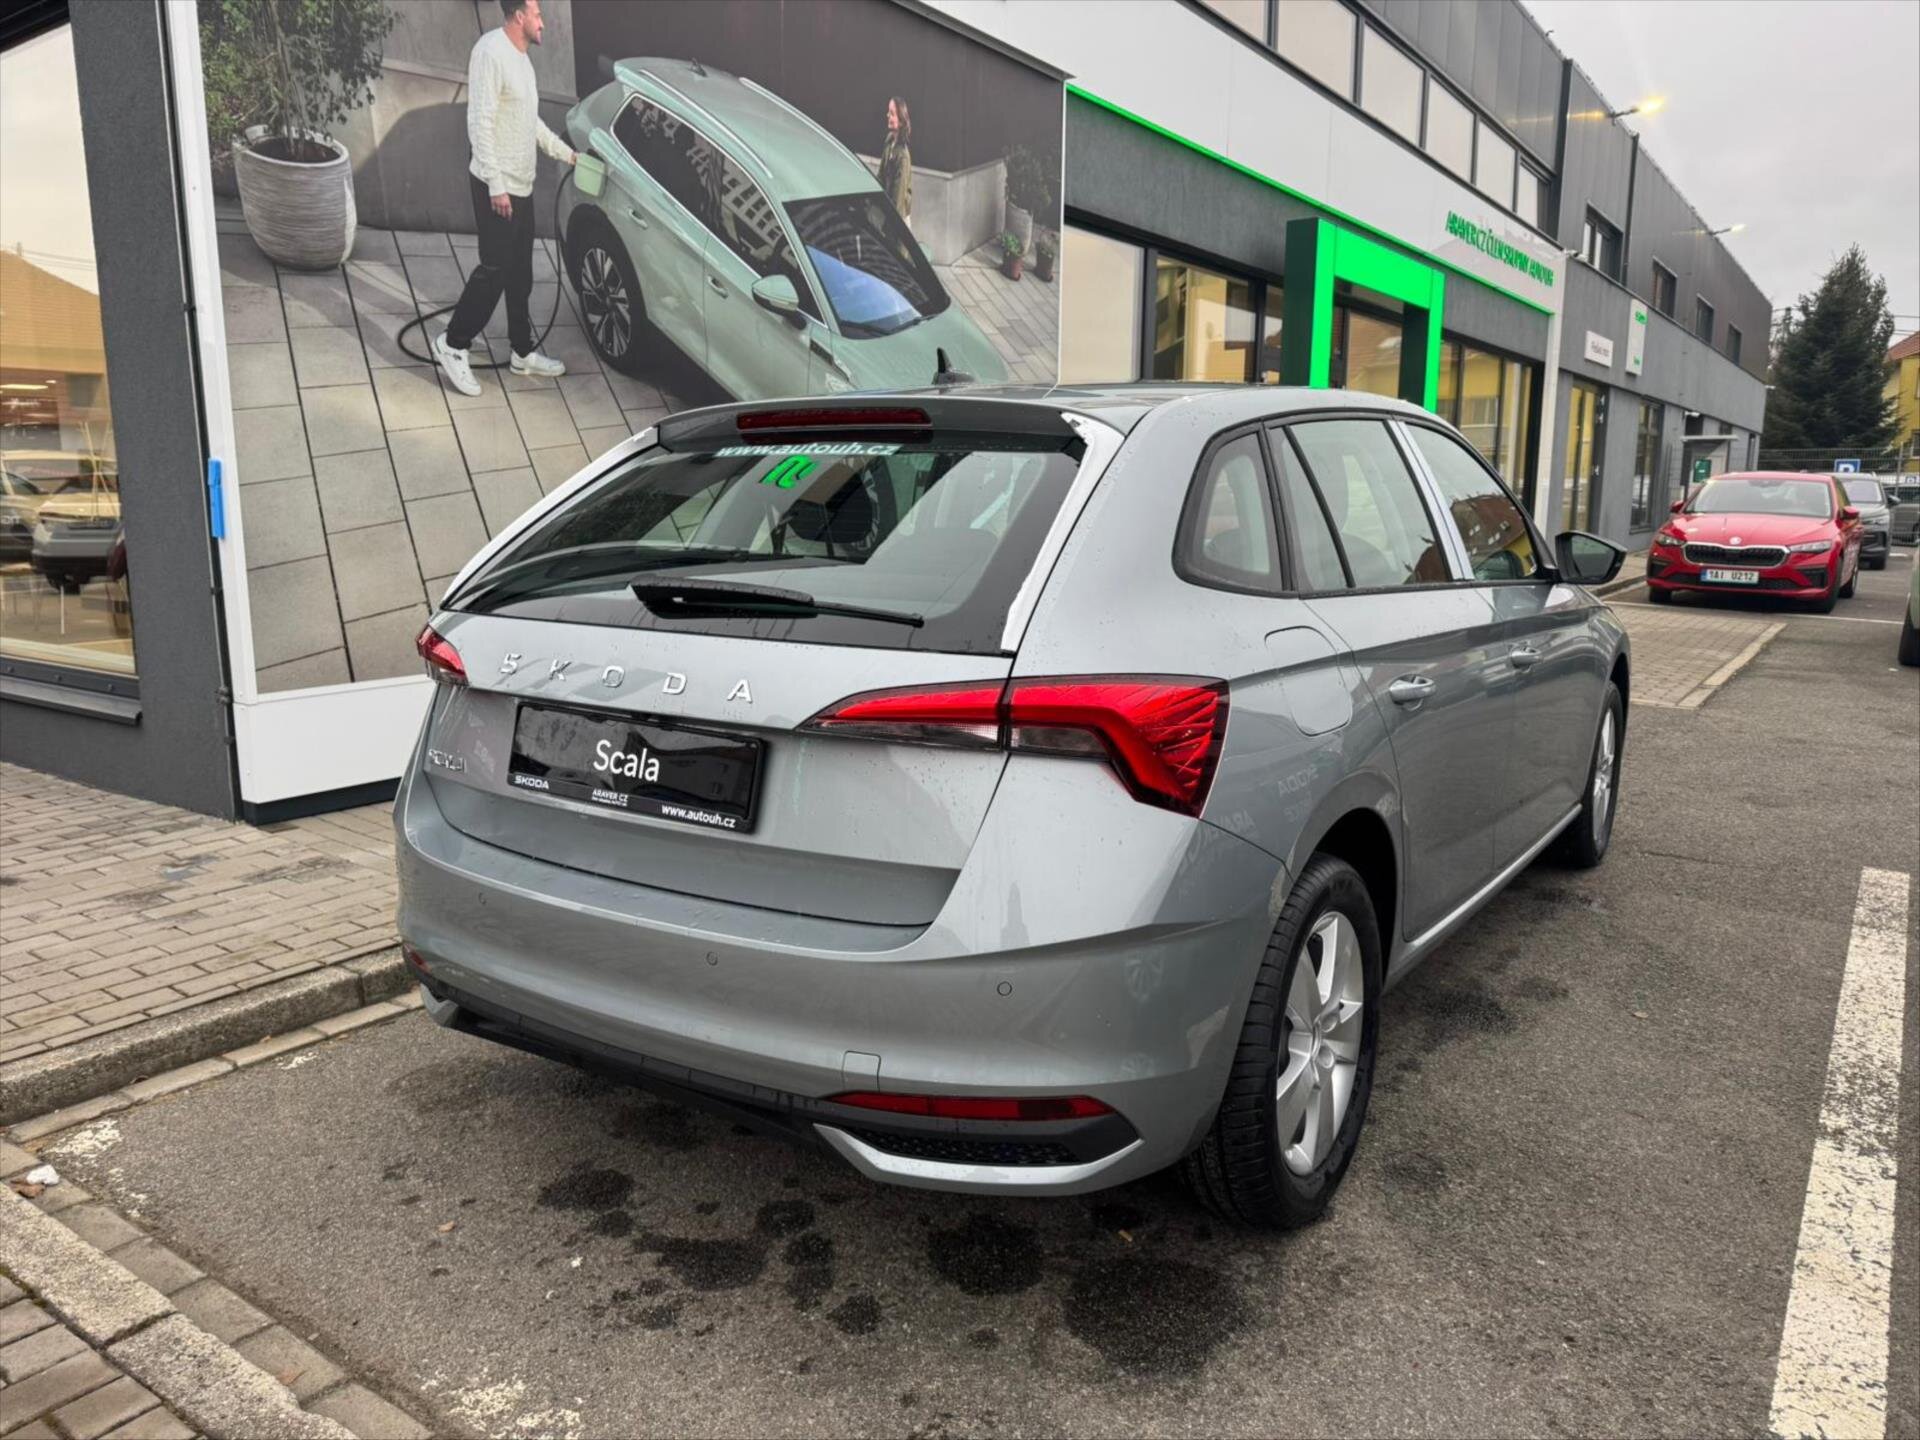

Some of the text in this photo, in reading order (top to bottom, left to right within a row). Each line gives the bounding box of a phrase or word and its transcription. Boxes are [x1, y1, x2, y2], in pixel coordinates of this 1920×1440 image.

[713, 442, 902, 457] www.autouh.cz
[593, 739, 660, 783] Scala
[661, 804, 736, 828] www.autouh.cz
